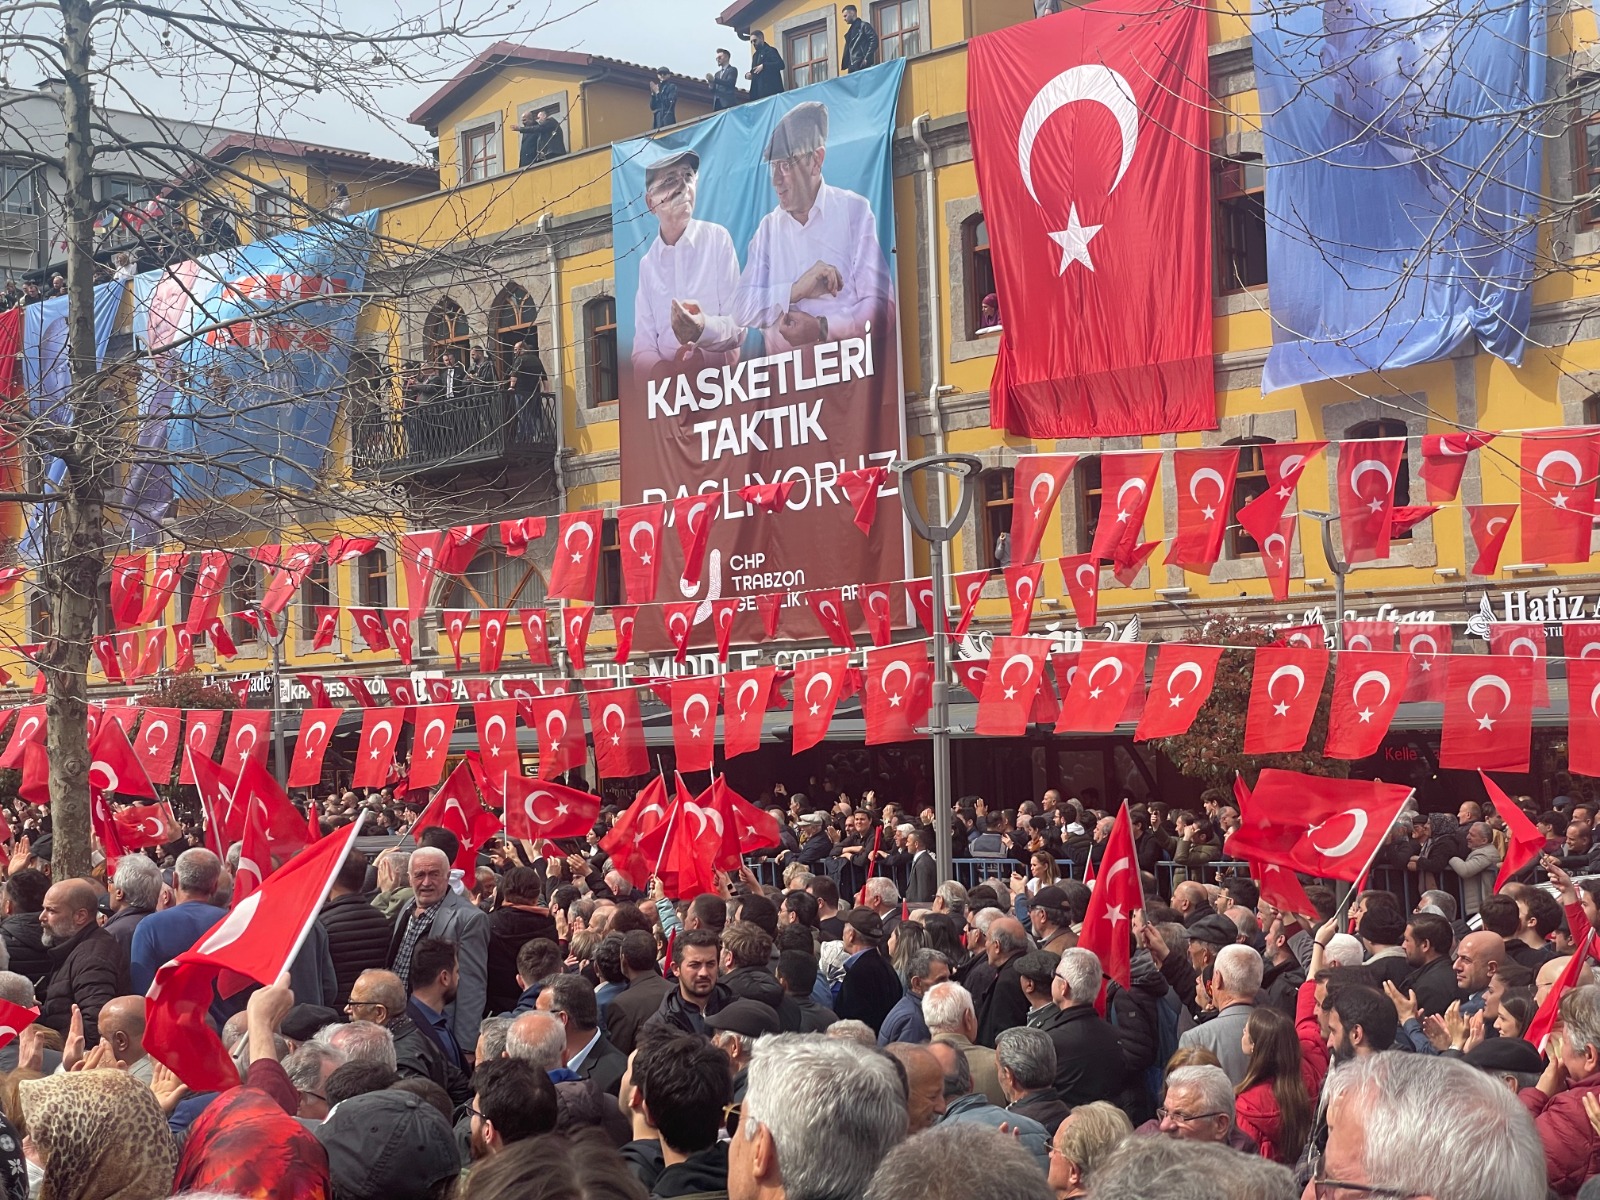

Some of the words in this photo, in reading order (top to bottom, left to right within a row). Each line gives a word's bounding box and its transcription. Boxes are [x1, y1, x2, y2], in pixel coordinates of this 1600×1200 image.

[648, 319, 875, 420] KASKETLERİ
[693, 398, 828, 462] TAKTIK
[729, 552, 766, 571] CHP
[731, 569, 805, 592] TRABZON
